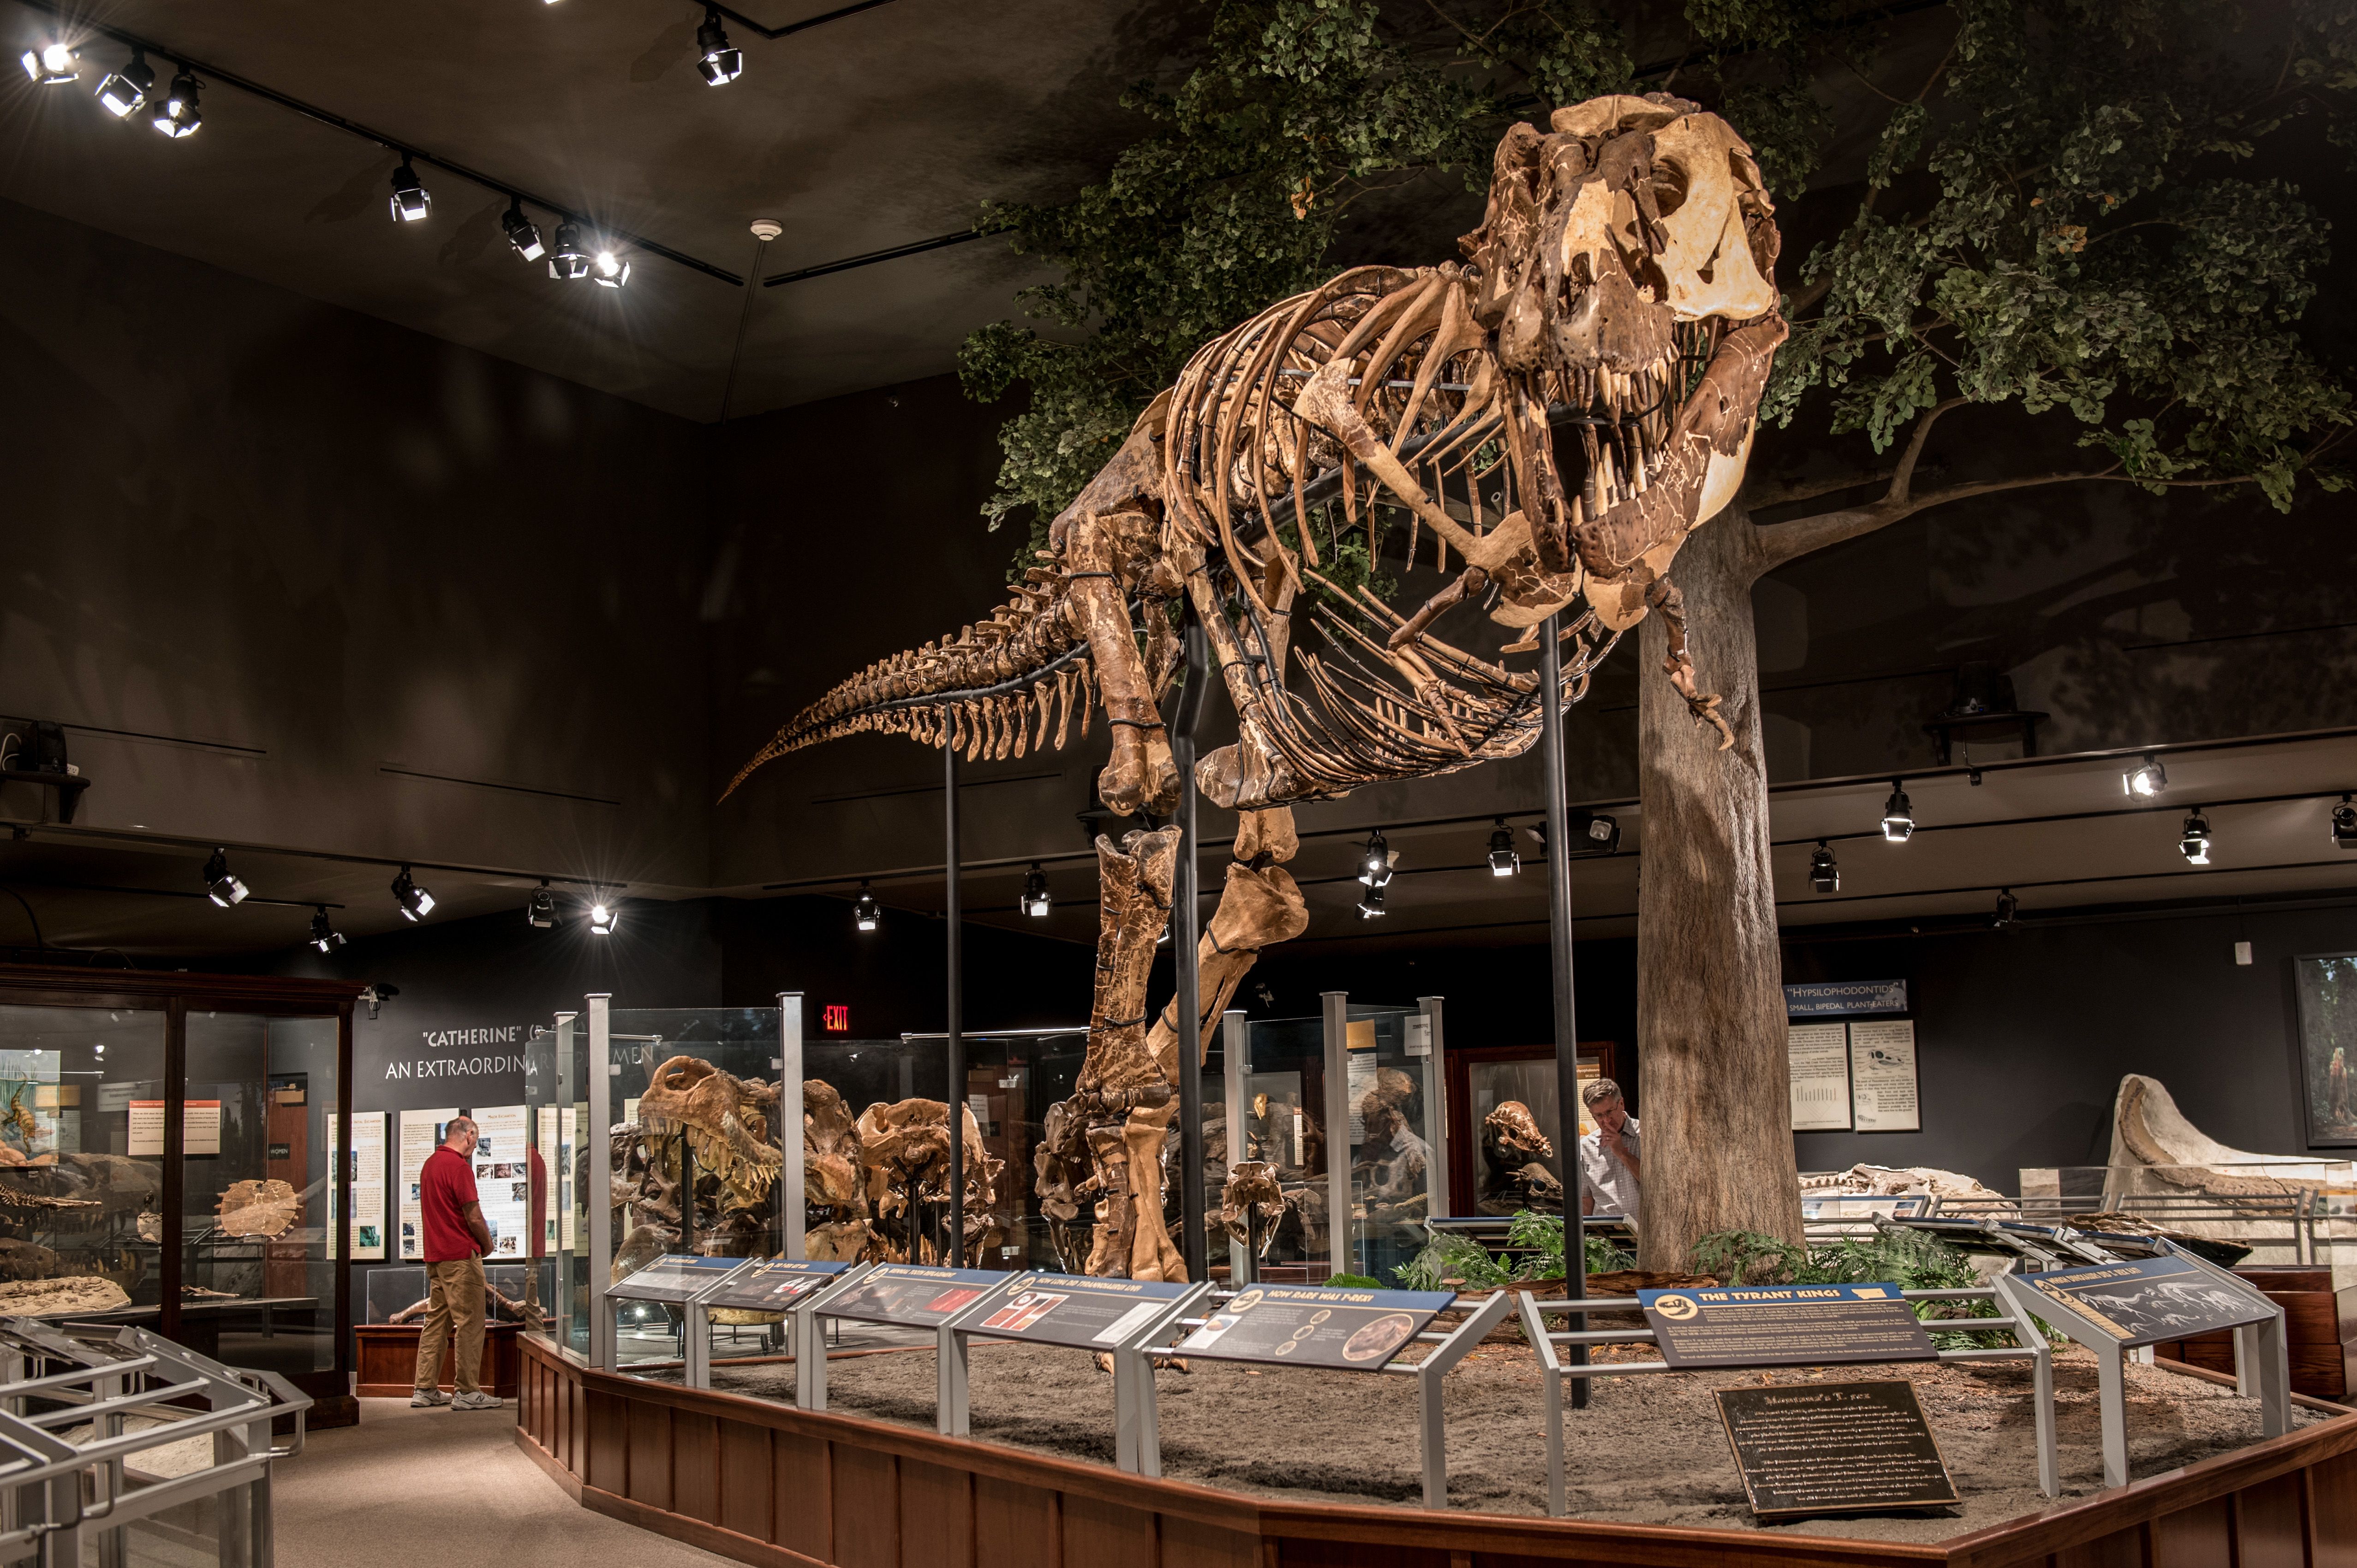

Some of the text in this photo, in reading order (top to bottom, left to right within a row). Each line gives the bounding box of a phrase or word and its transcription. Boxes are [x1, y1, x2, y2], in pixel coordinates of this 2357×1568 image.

[1847, 1000, 1898, 1009] PLANT-EATERS
[827, 1006, 848, 1030] EXIT
[423, 1026, 521, 1047] "CATHERINE"
[385, 1062, 410, 1079] AN
[2066, 1272, 2102, 1282] DINOSAURS
[1267, 1290, 1292, 1298] HOW
[1291, 1291, 1319, 1300] RARE
[1318, 1292, 1341, 1301] WAS
[1698, 1289, 1841, 1301] THE TYRANT KINGS
[1764, 1394, 1831, 1406] Montana's
[1832, 1392, 1847, 1401] T.
